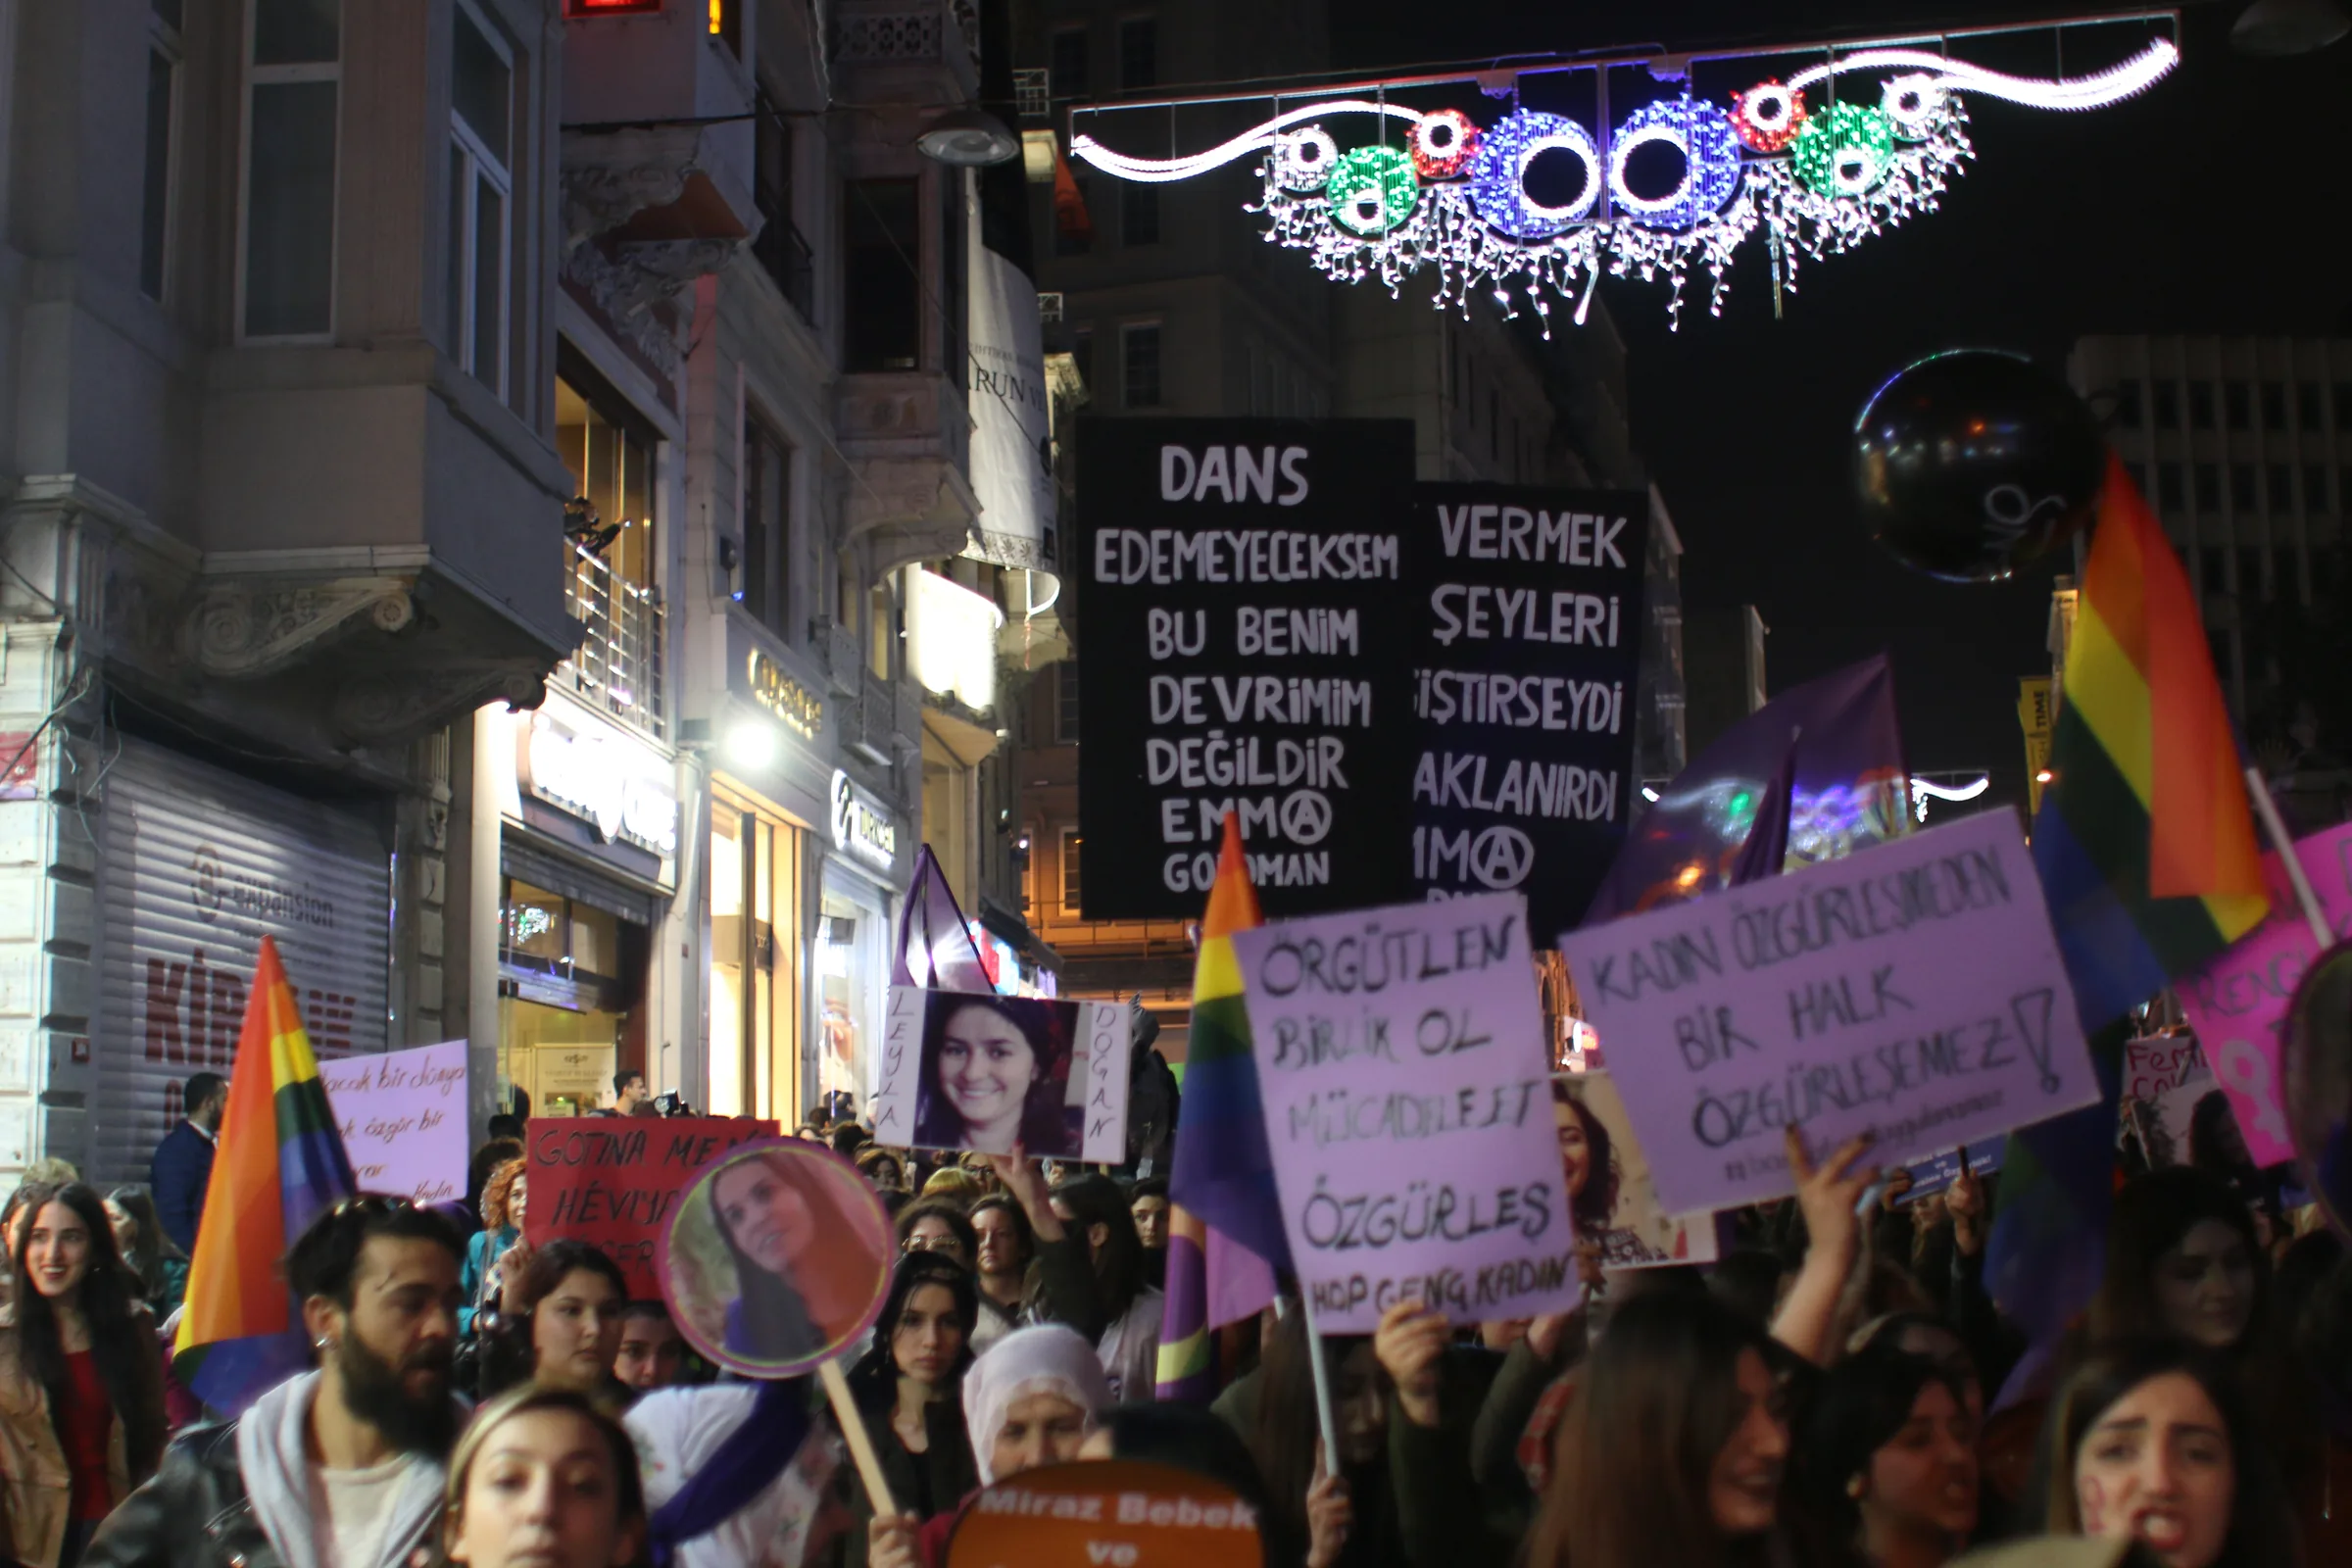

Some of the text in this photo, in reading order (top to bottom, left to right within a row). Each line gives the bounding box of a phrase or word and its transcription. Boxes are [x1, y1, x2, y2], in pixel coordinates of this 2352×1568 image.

[1161, 445, 1309, 505] DANS
[1095, 528, 1398, 585] EDEMEYECEKSEM
[1437, 504, 1628, 568] VERMEK
[1148, 608, 1207, 660] BU
[1414, 669, 1623, 735] İŞTİRSEYDİ
[1413, 752, 1618, 821] AKLANIRDI
[1163, 851, 1330, 893] GOMAN
[1260, 915, 1517, 998] ÖRGÜTLEN
[1417, 1008, 1493, 1056] OL
[1674, 962, 1916, 1072] BİR HALK
[878, 990, 915, 1129] LEYLA
[980, 1488, 1259, 1531] Miraz Bebek
[1086, 1540, 1140, 1567] ve
